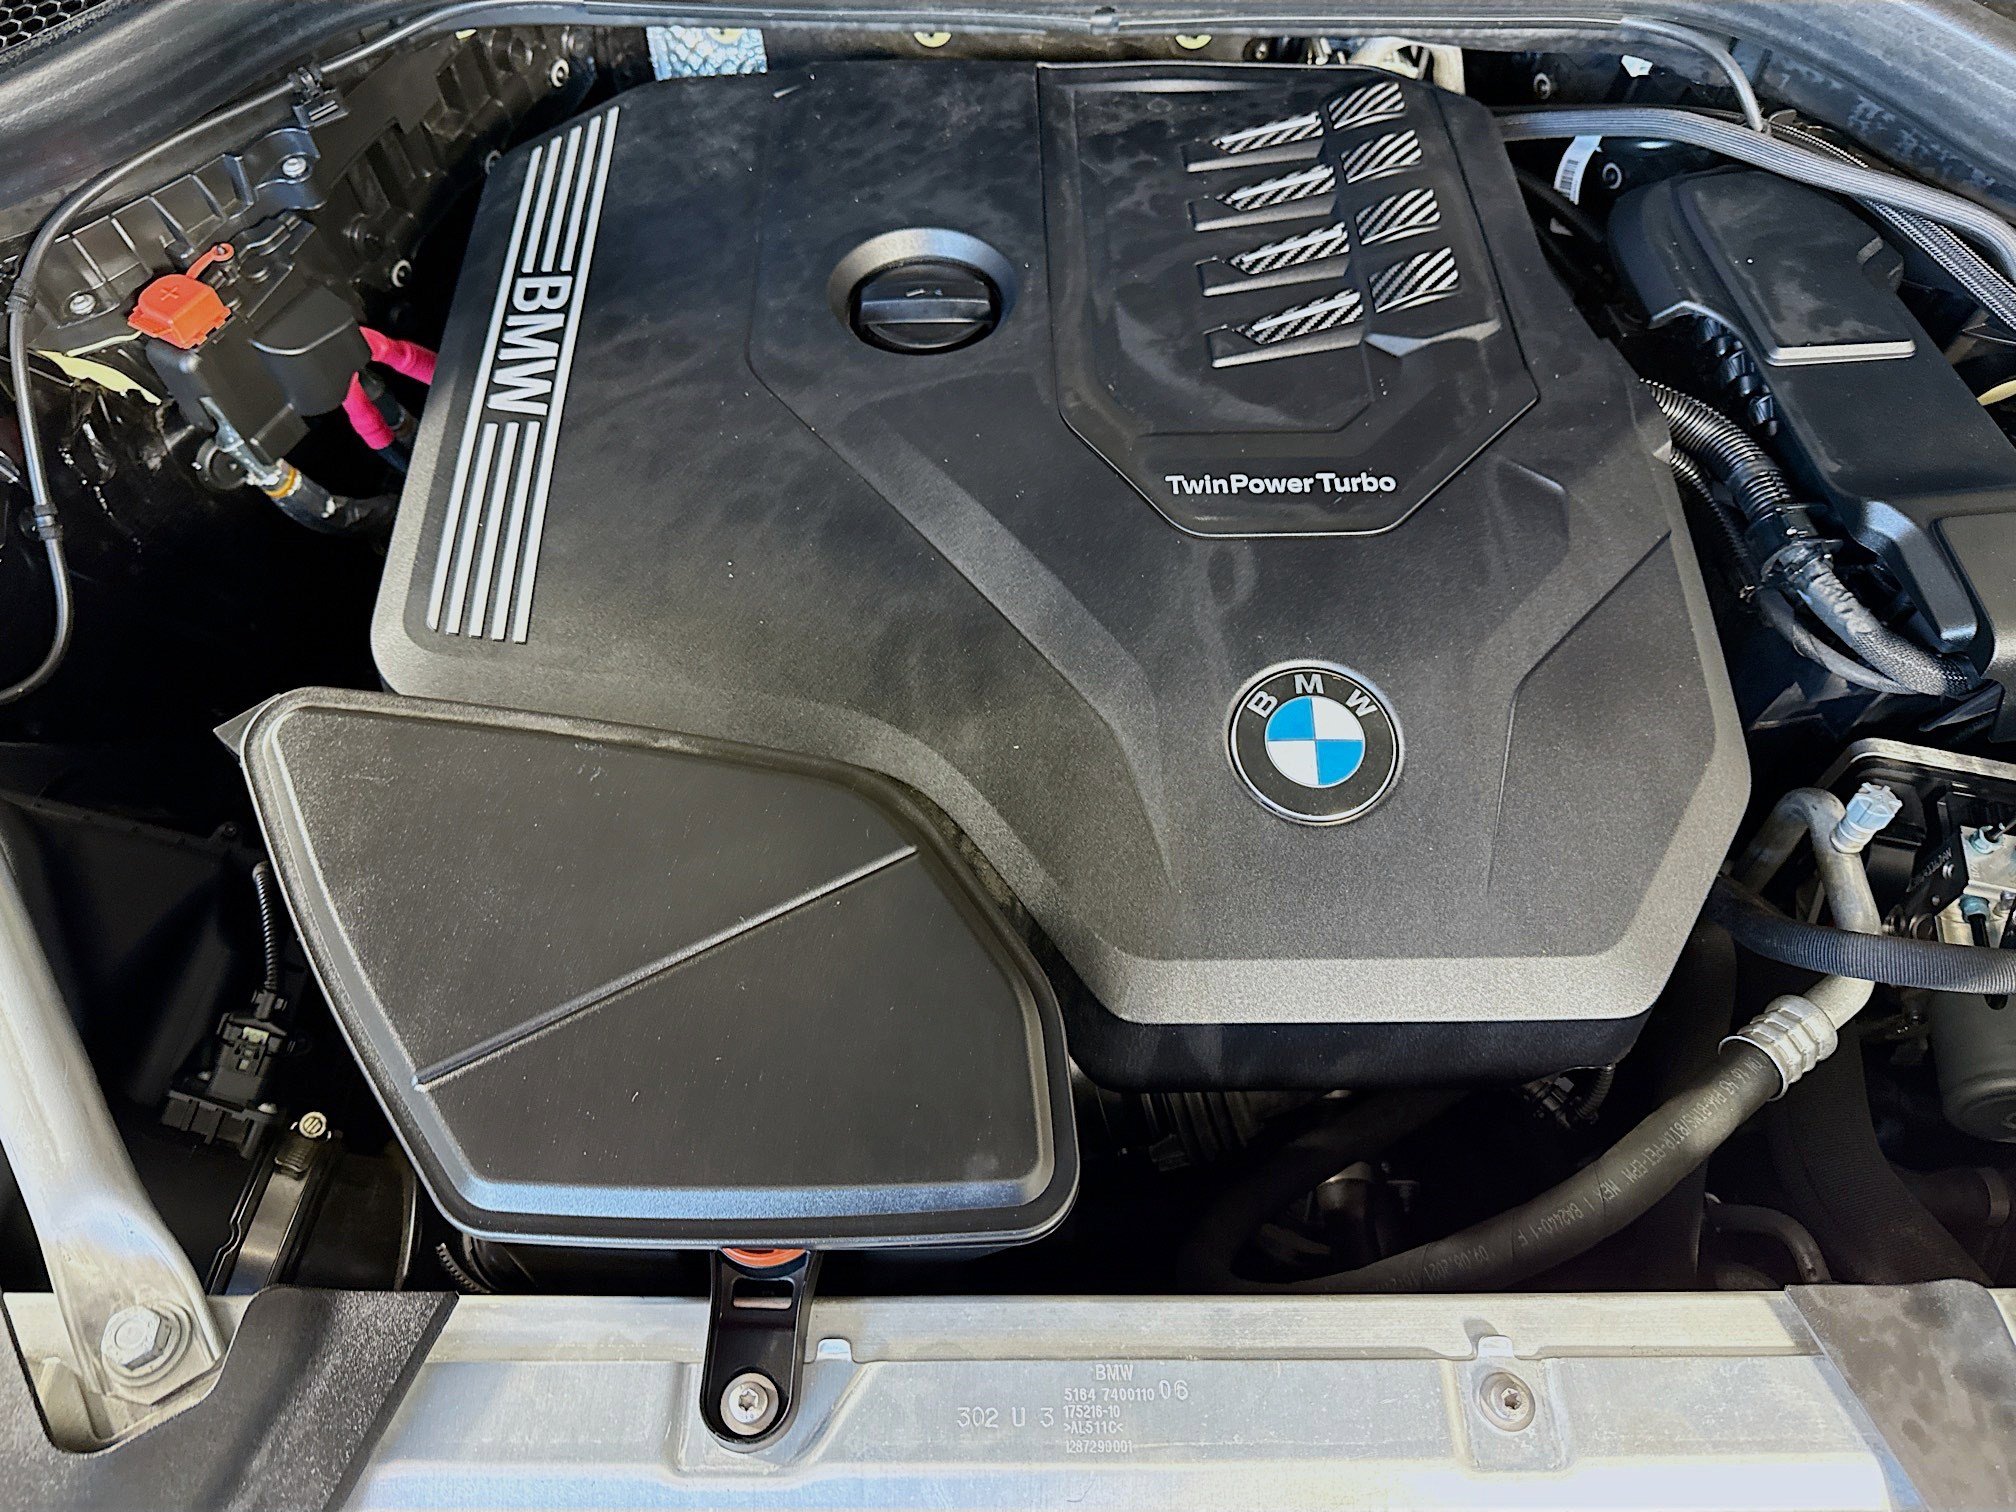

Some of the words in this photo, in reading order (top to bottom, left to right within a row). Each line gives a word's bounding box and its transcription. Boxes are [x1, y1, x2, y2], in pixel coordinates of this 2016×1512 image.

[486, 275, 573, 416] BMW
[1165, 473, 1314, 495] TwinPower
[1315, 471, 1396, 493] Turbo
[1246, 673, 1378, 719] BMW
[1095, 1363, 1134, 1381] BMW
[1064, 1387, 1096, 1402] 5164
[1102, 1387, 1155, 1402] 7400110
[957, 1406, 999, 1428] 302
[1012, 1407, 1025, 1427] U
[1041, 1407, 1054, 1427] 3
[1063, 1404, 1121, 1419] 175216-10
